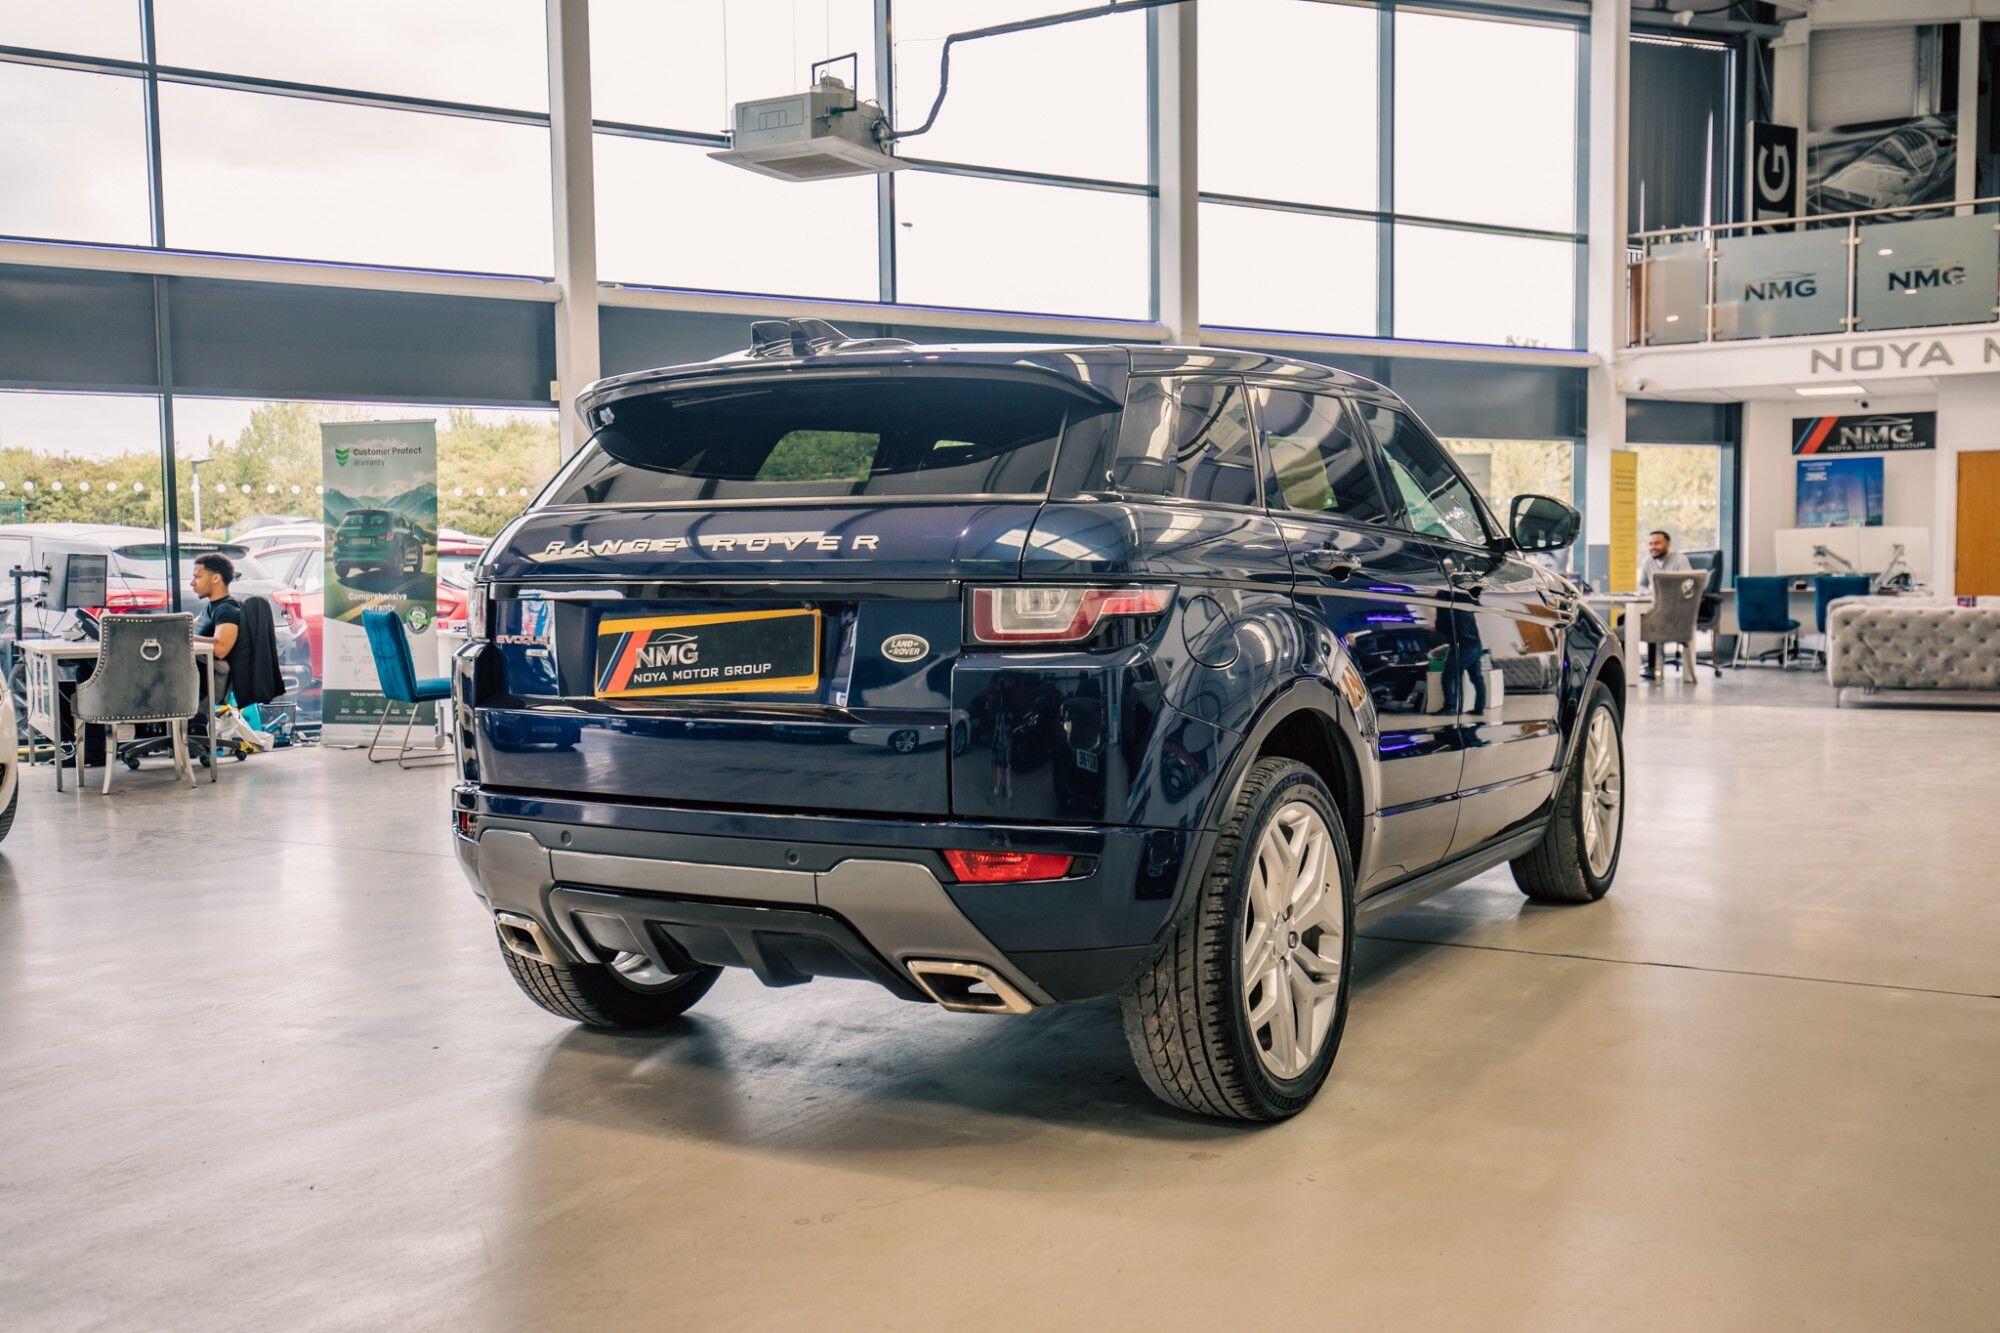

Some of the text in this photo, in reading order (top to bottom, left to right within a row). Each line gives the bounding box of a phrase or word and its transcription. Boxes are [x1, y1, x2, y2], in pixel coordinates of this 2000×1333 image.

[1888, 267, 1966, 291] NMG
[1745, 279, 1817, 301] NMG
[1811, 341, 1955, 373] NOYA
[1840, 424, 1914, 445] NMG
[353, 445, 422, 456] Customer Protect
[1828, 441, 1926, 452] NOYA MOTOR GROUP
[354, 459, 385, 467] Warranty
[545, 535, 881, 556] RANGE ROVER
[348, 592, 408, 601] Comprehensive
[891, 640, 914, 648] LAND
[893, 647, 920, 656] ROVER
[635, 643, 698, 669] NMG
[633, 663, 772, 684] NOYA MOTOR GROUP
